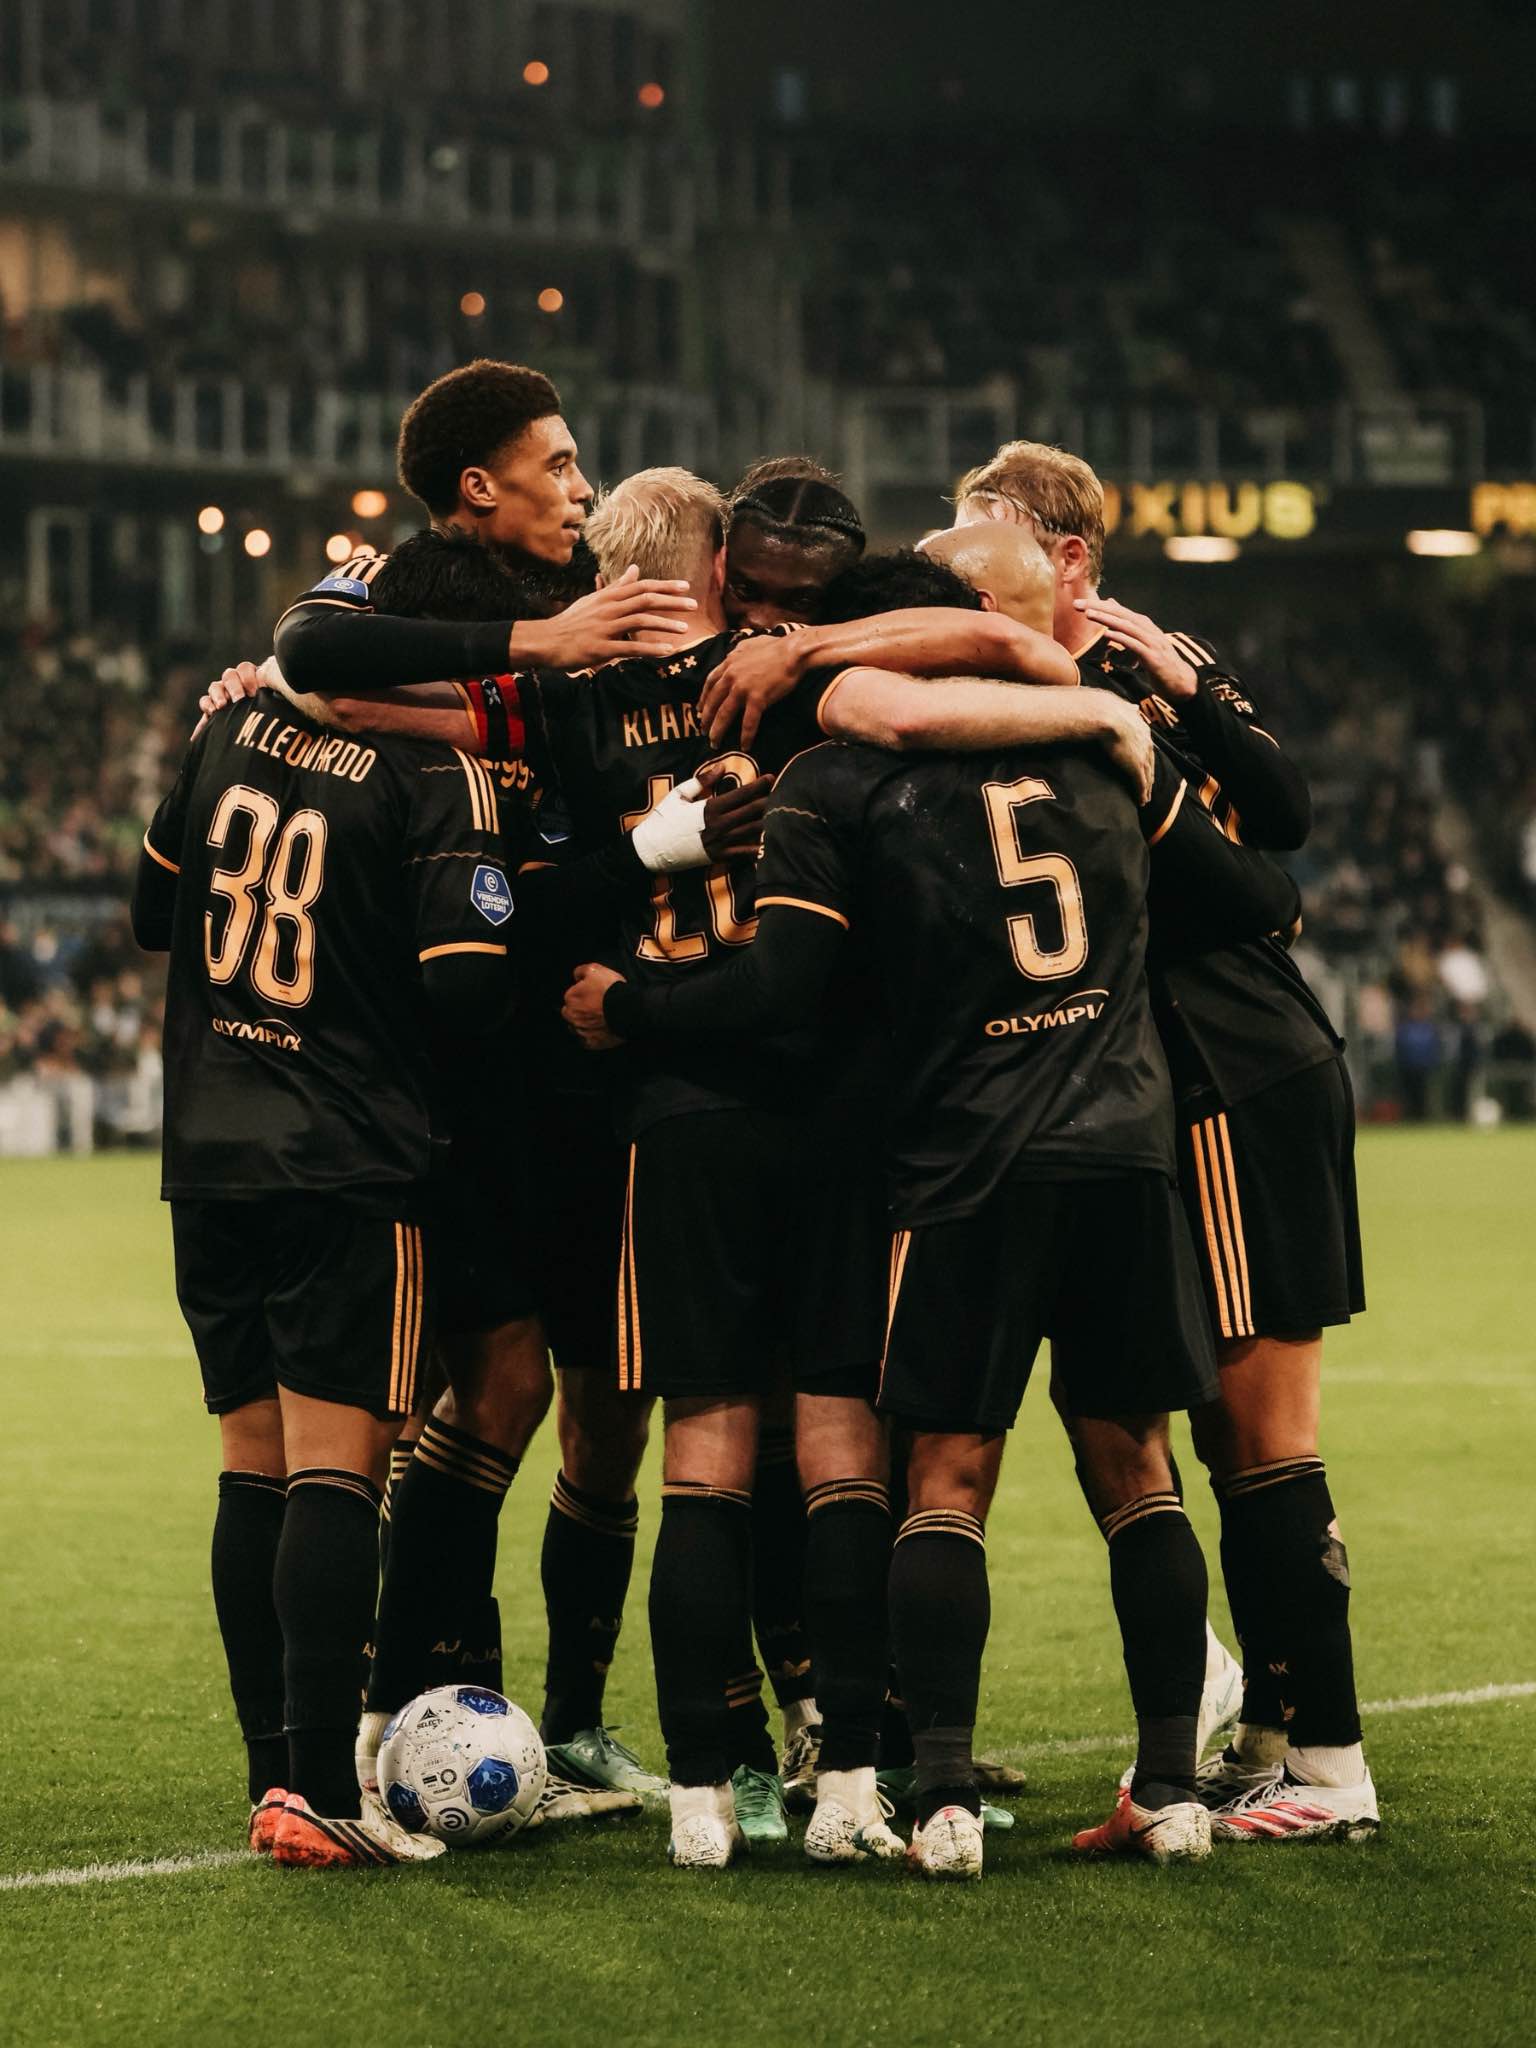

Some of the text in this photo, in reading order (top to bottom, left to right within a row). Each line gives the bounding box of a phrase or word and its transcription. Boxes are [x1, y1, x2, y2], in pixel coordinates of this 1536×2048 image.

[203, 784, 328, 1009] 38
[981, 776, 1089, 982] 5
[416, 1719, 442, 1730] SELECT
